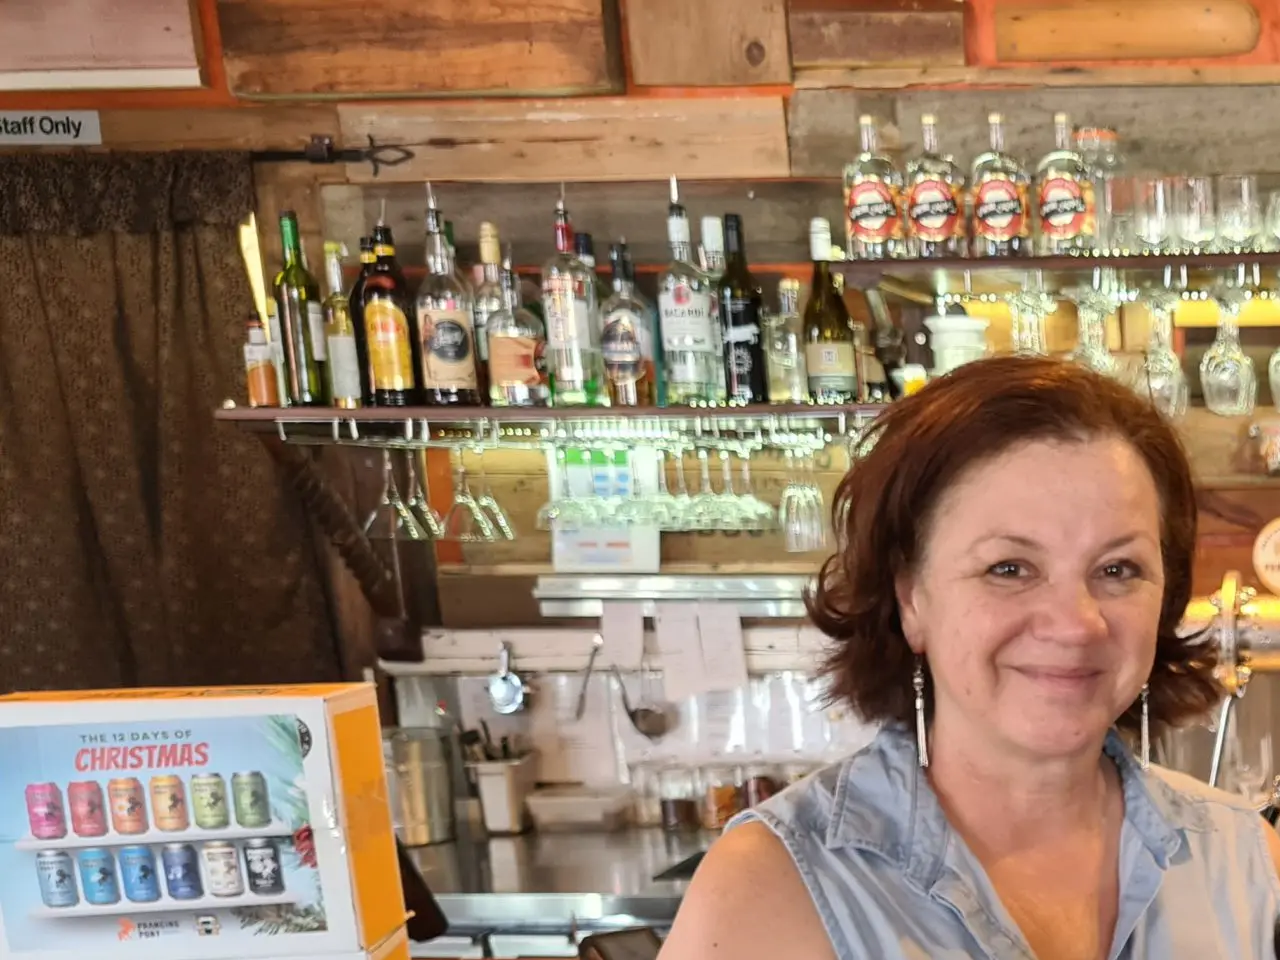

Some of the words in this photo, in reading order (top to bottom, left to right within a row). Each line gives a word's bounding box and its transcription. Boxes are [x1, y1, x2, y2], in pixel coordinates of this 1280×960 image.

[39, 116, 82, 138] Only
[80, 733, 108, 744] THE
[112, 732, 126, 743] 12
[130, 730, 169, 742] DAYS
[174, 729, 192, 740] OF
[74, 742, 210, 773] CHRISTMAS
